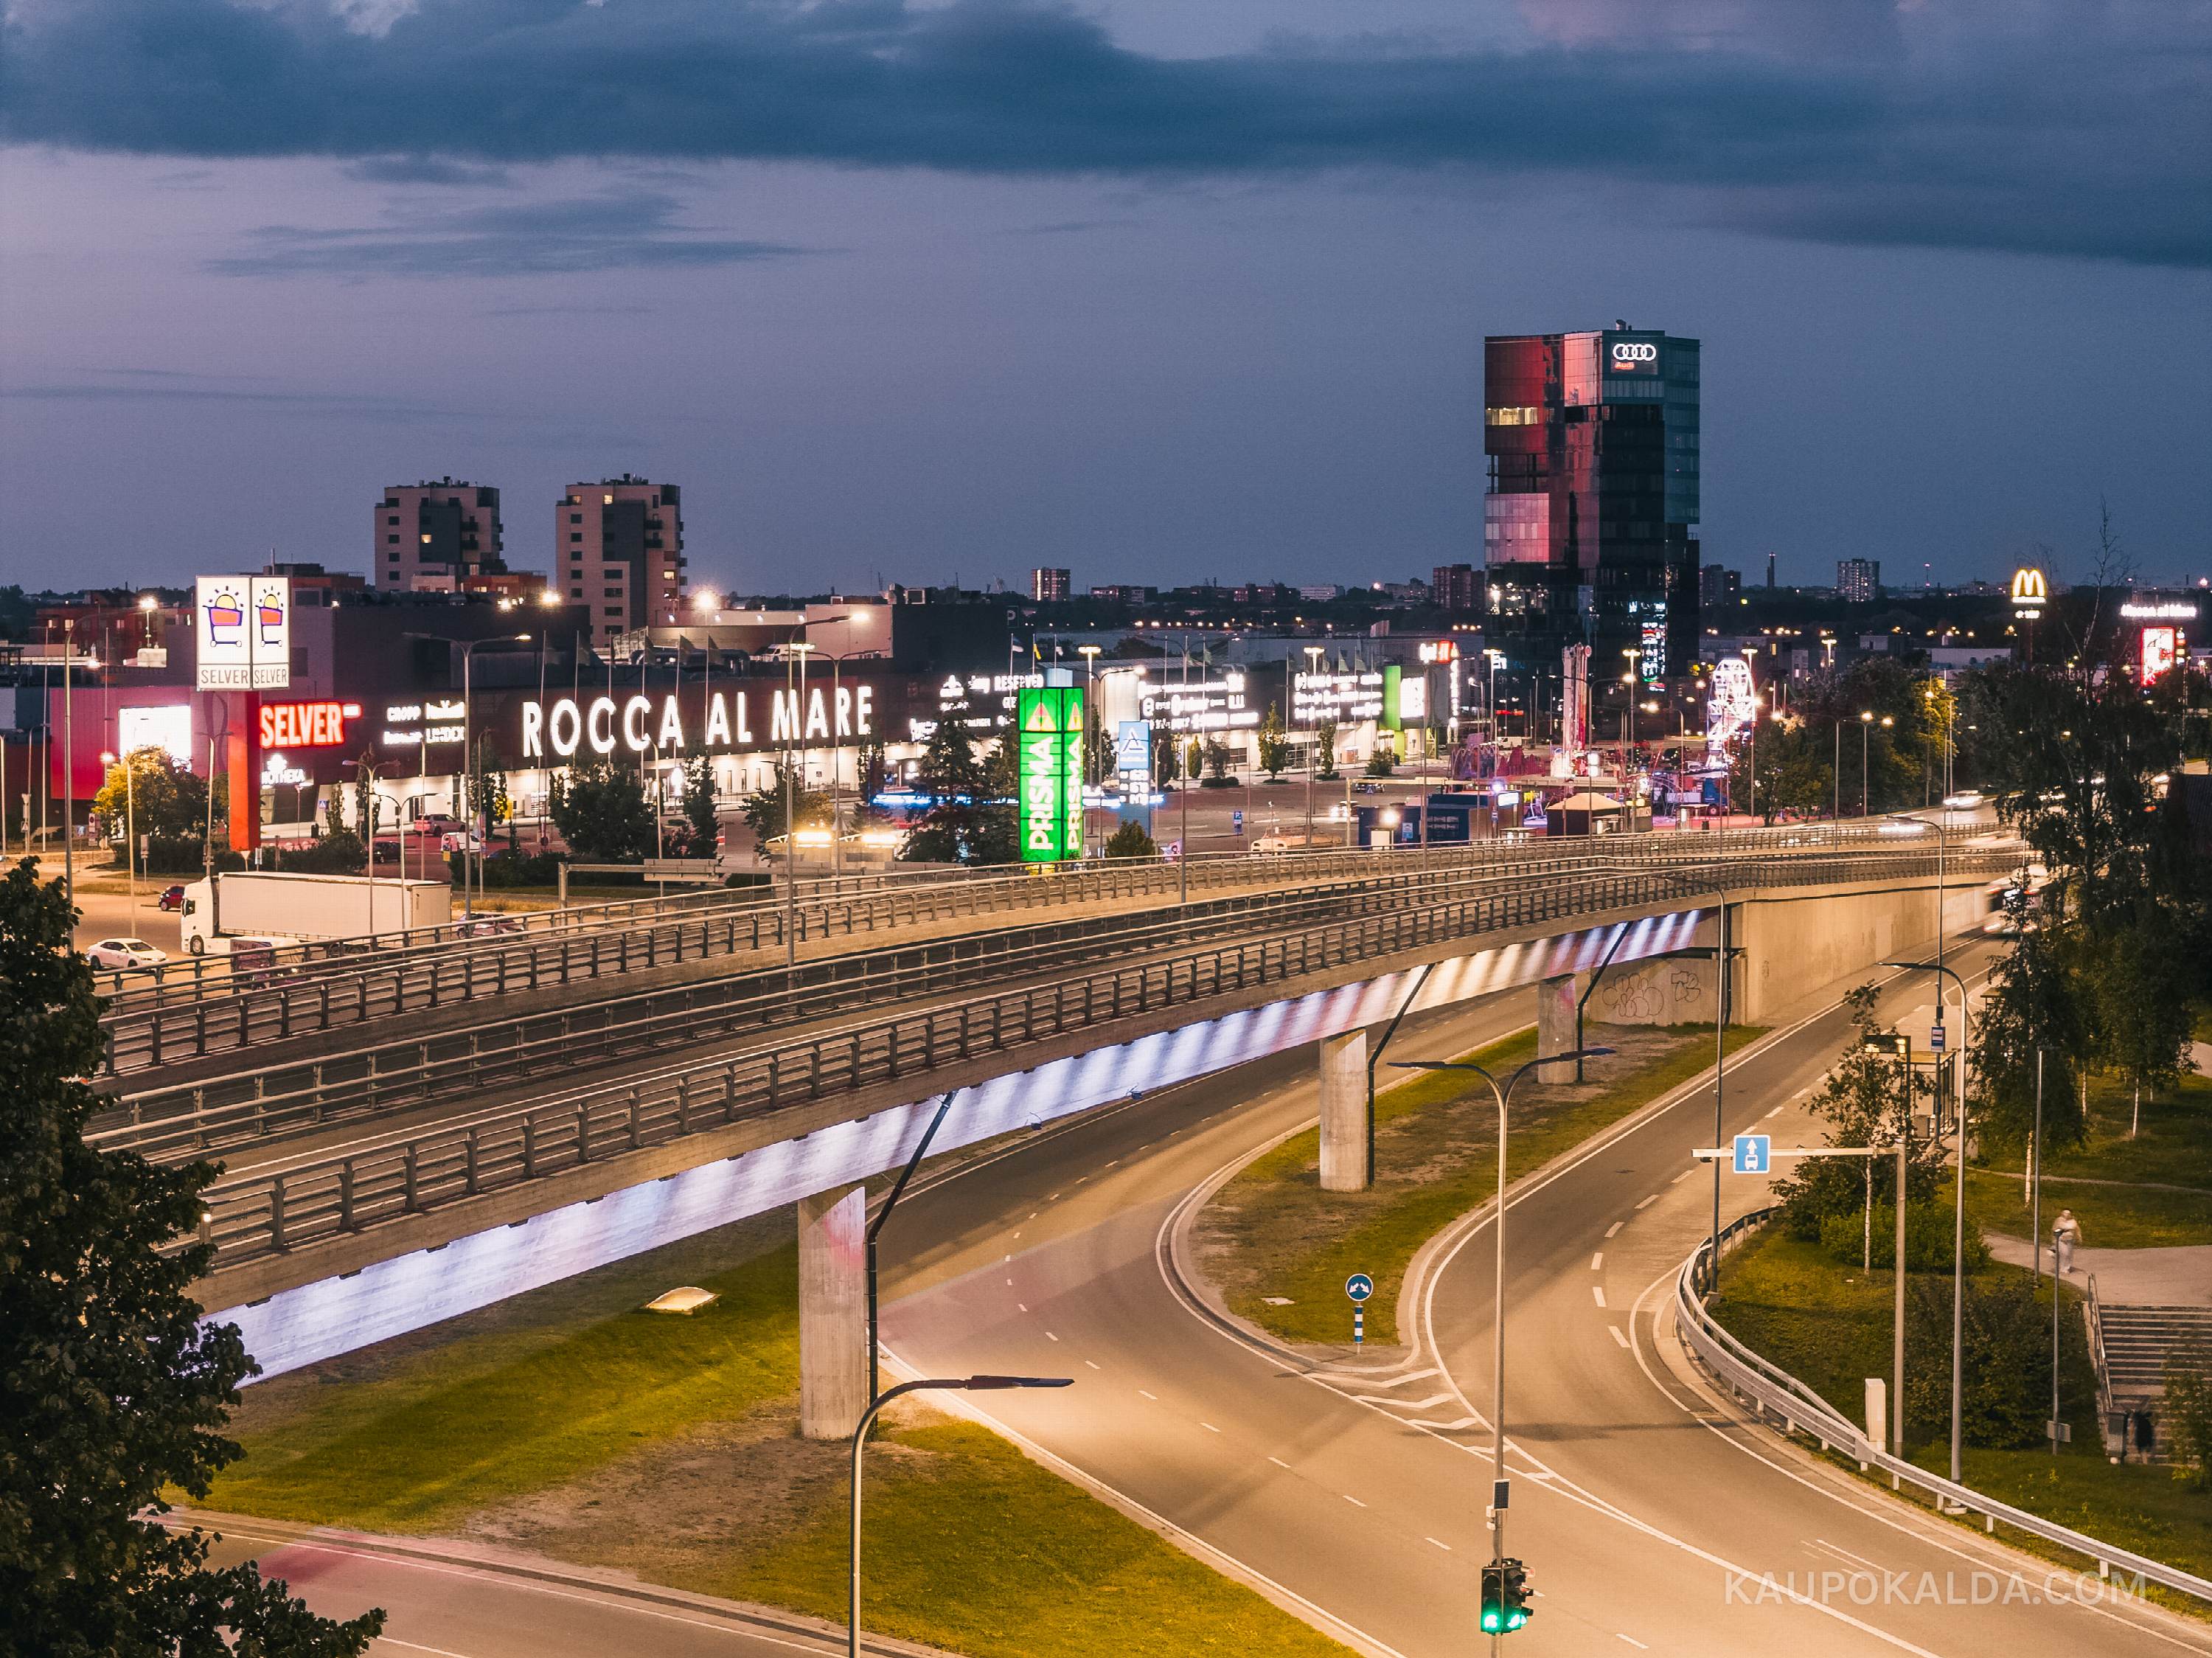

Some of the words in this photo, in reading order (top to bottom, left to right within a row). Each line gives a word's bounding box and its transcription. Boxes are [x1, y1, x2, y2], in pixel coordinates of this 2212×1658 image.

[1615, 361, 1635, 370] Audi
[1007, 610, 1016, 625] P
[201, 669, 249, 684] SELVER
[254, 668, 288, 684] SELVER
[261, 703, 344, 747] SELVER
[522, 696, 685, 757] ROCCA
[705, 691, 753, 746] AL
[771, 686, 873, 742] MARE
[1029, 736, 1054, 850] PRISMA
[1067, 735, 1082, 850] PRISMA
